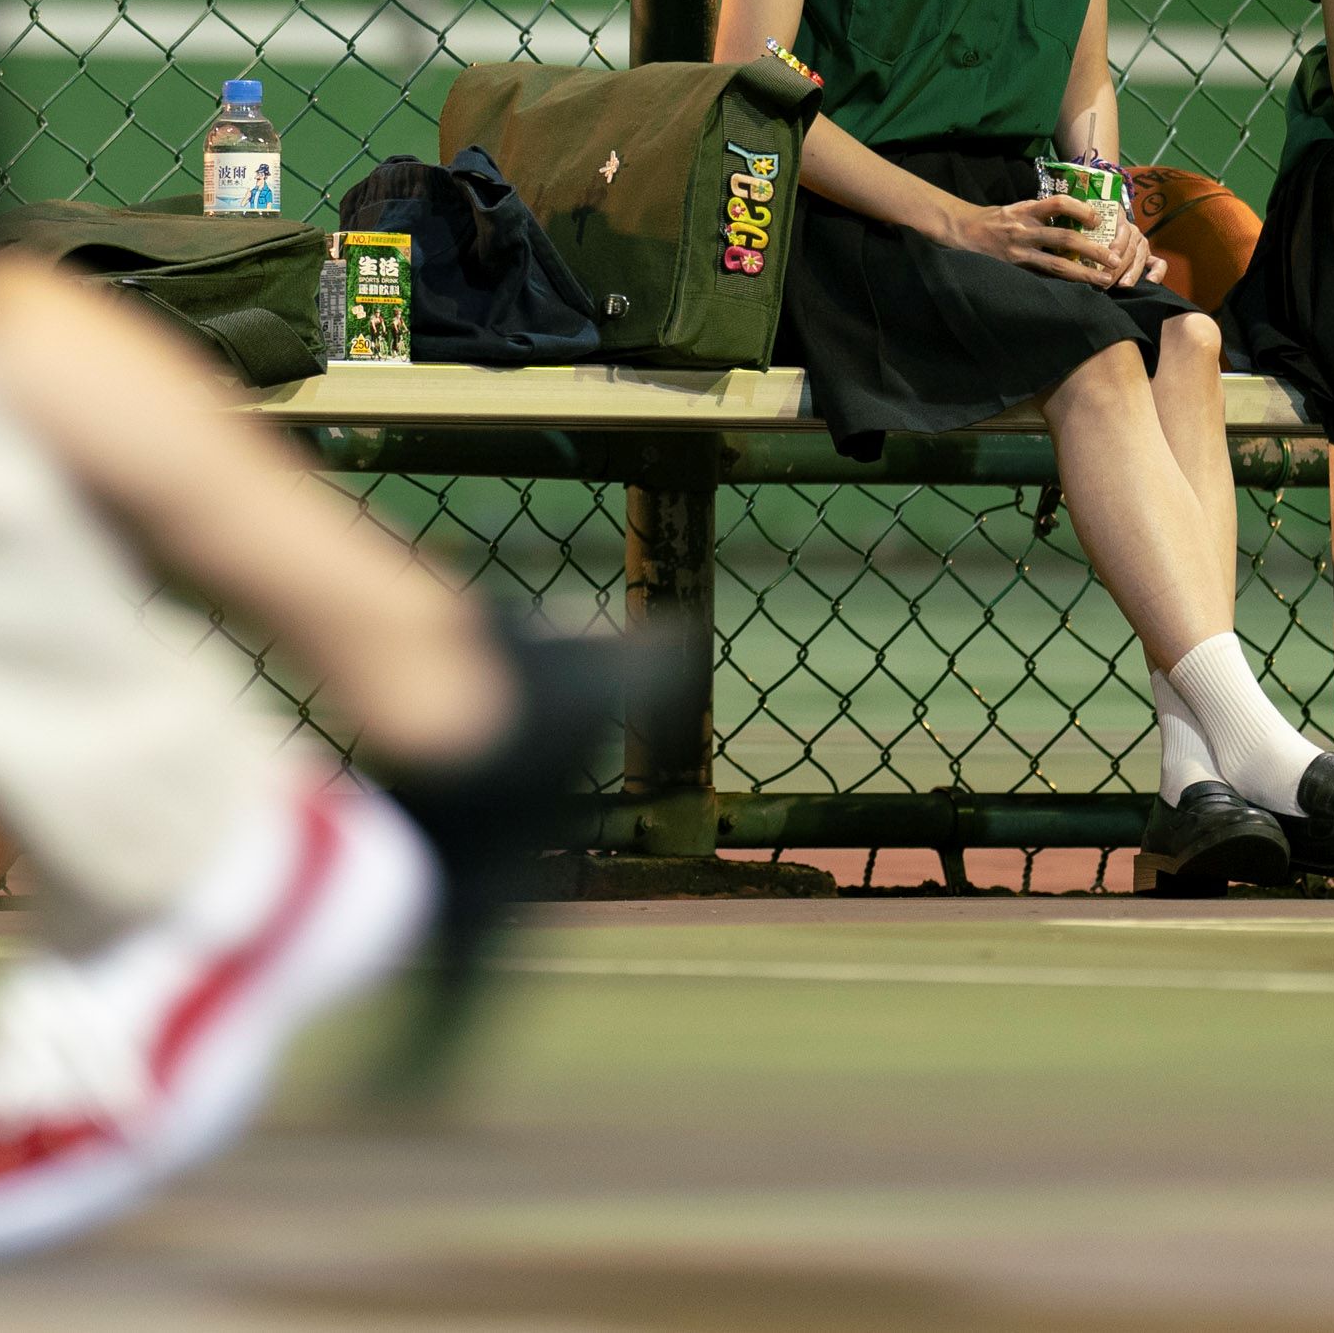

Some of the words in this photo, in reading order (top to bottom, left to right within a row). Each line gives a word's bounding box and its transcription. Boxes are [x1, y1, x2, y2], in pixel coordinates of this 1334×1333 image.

[352, 235, 371, 244] NO.1
[358, 255, 399, 277] 生活
[352, 339, 370, 349] 250
